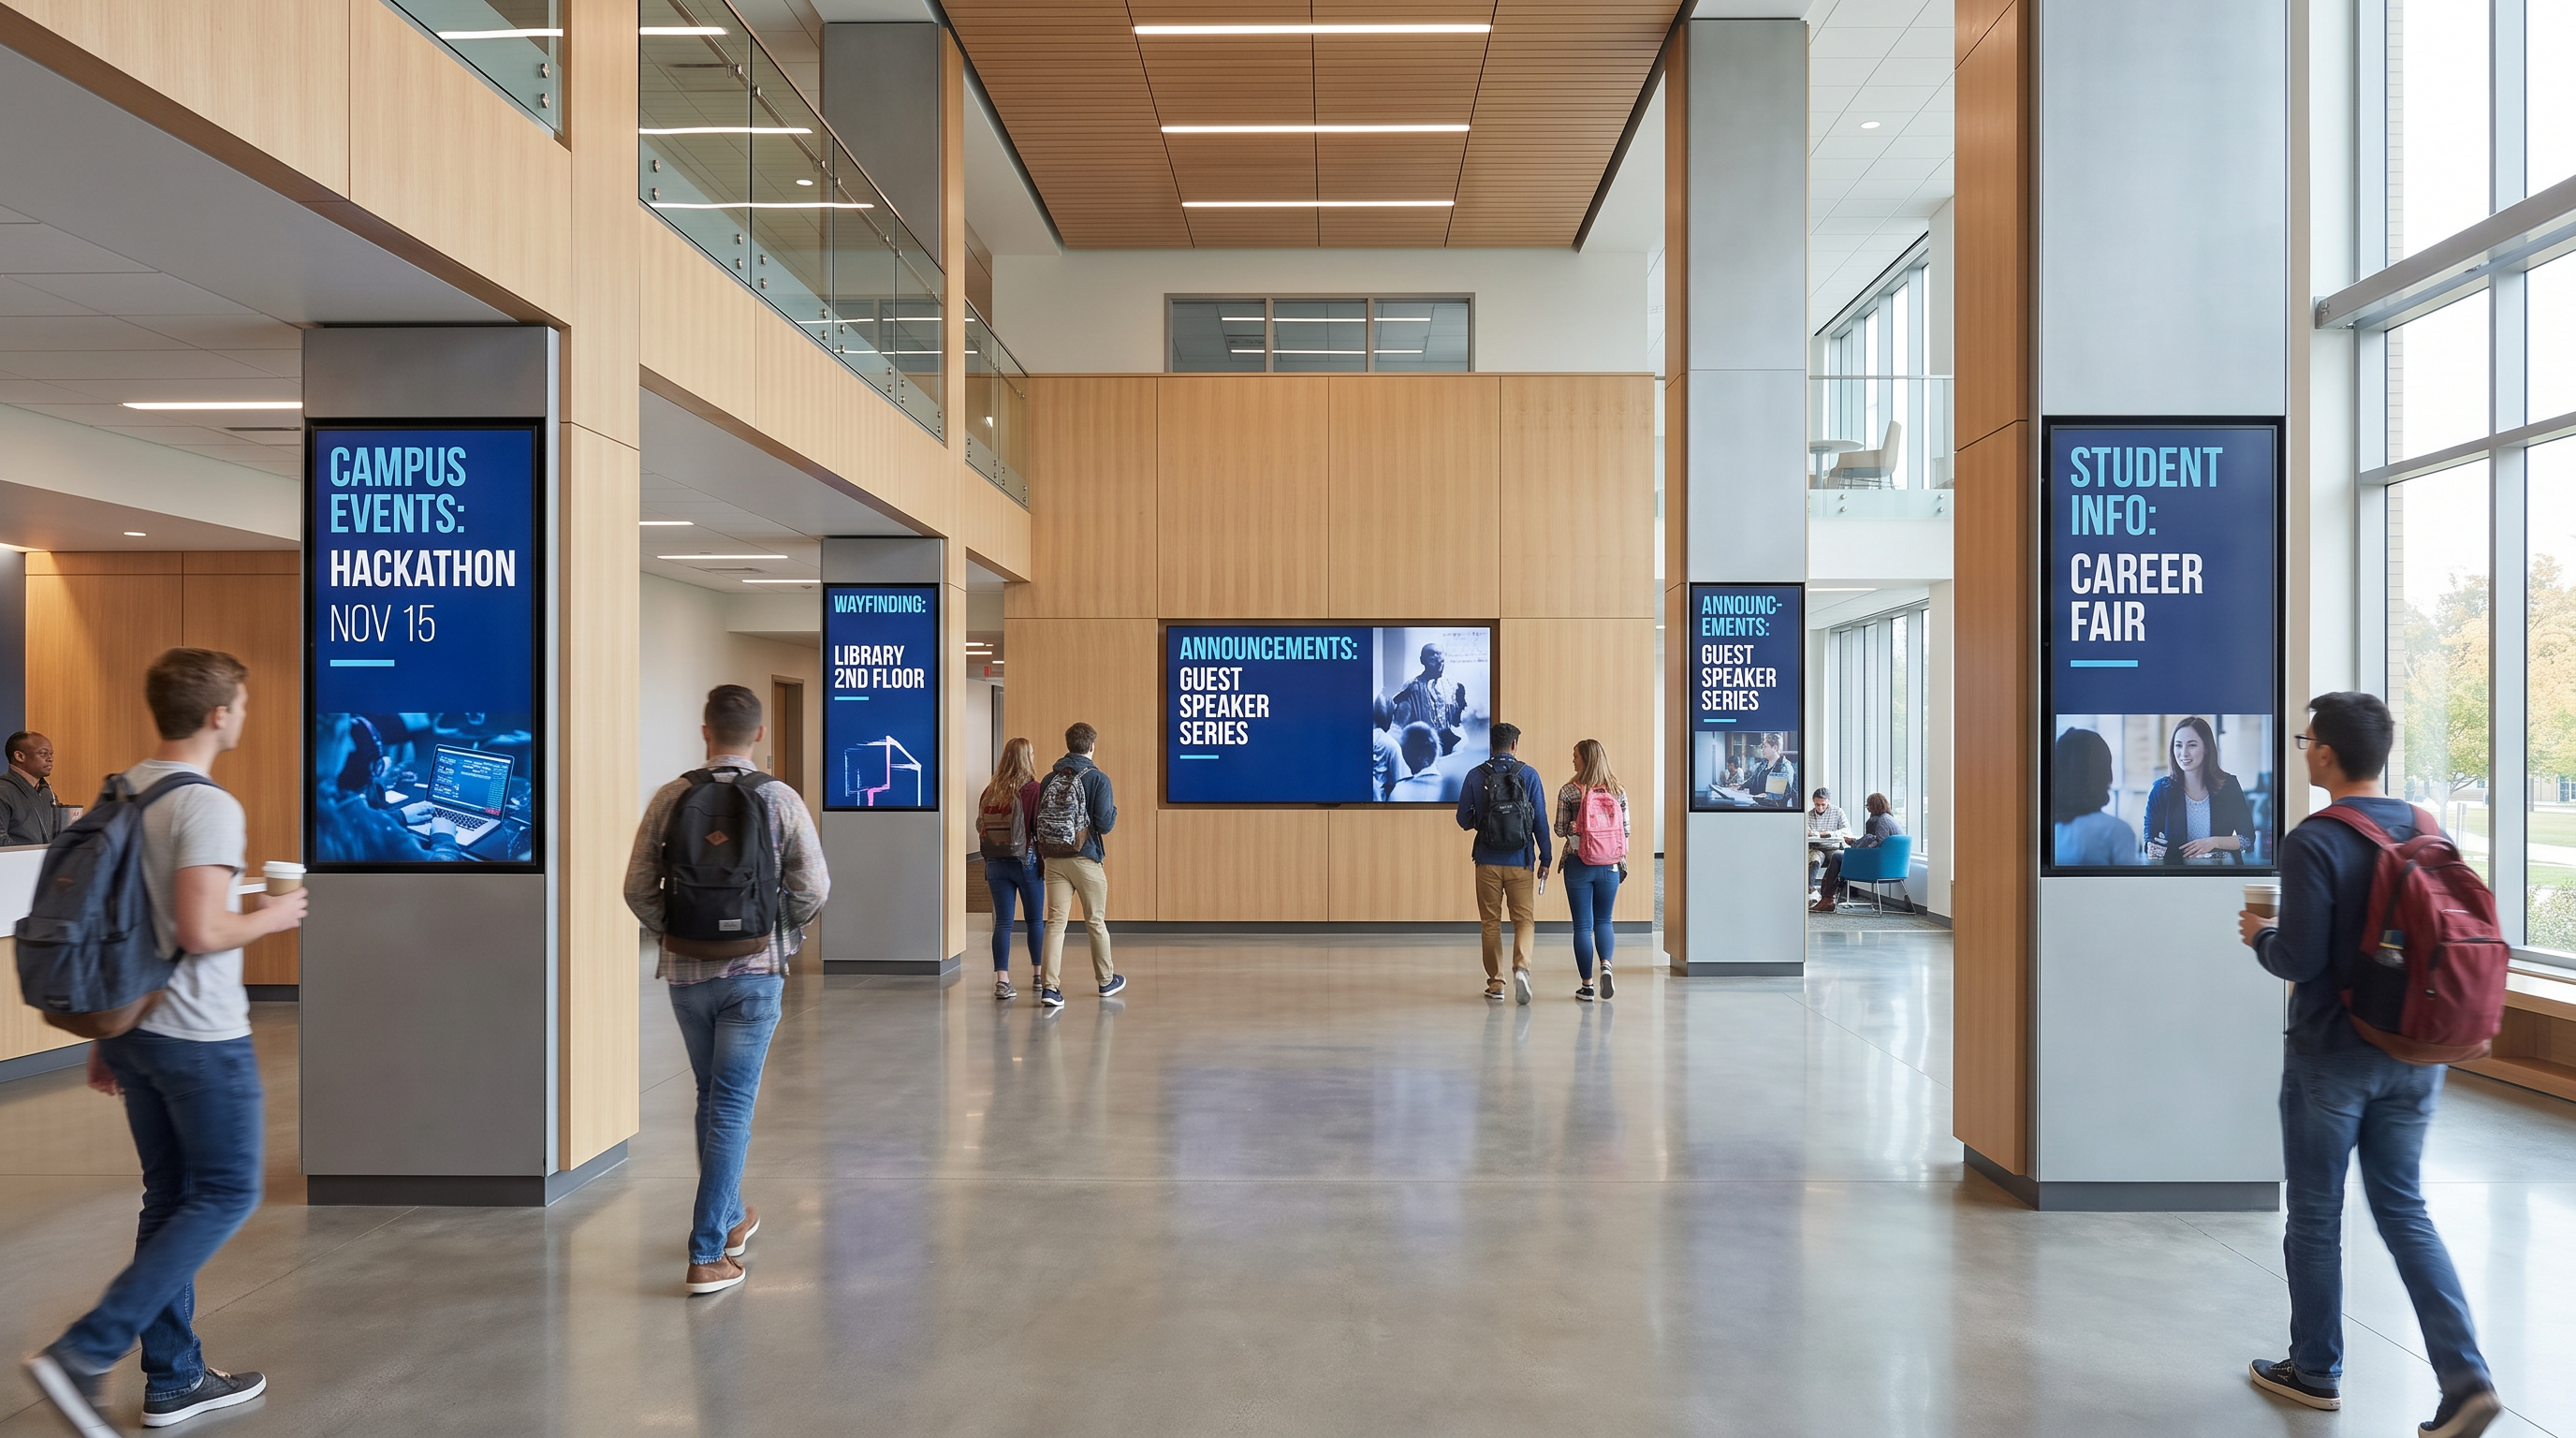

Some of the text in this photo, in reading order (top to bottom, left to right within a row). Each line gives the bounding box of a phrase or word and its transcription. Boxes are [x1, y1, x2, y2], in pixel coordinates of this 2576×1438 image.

[330, 446, 467, 487] CAMPUS
[2070, 446, 2224, 488] STUDENT
[330, 492, 465, 534] EVENTS:
[2071, 494, 2157, 536] INFO:
[330, 549, 516, 587] HACKATHON
[2071, 552, 2203, 594] CAREER
[834, 594, 927, 613] WAYFINDING:
[1701, 594, 1783, 615] ANNOUNC-
[330, 604, 435, 642] NOV 15
[1702, 617, 1770, 637] EMENTS:
[2071, 601, 2145, 642] FAIR
[834, 645, 905, 666] LIBRARY
[1179, 636, 1358, 661] ANNOUNCEMENTS:
[1701, 644, 1754, 665] GUEST
[834, 668, 925, 689] 2ND FLOOR
[1179, 667, 1243, 692] GUEST
[1701, 667, 1777, 688] SPEAKER
[1179, 694, 1269, 718] SPEAKER
[1701, 690, 1760, 711] SERIES
[1179, 720, 1249, 745] SERIES
